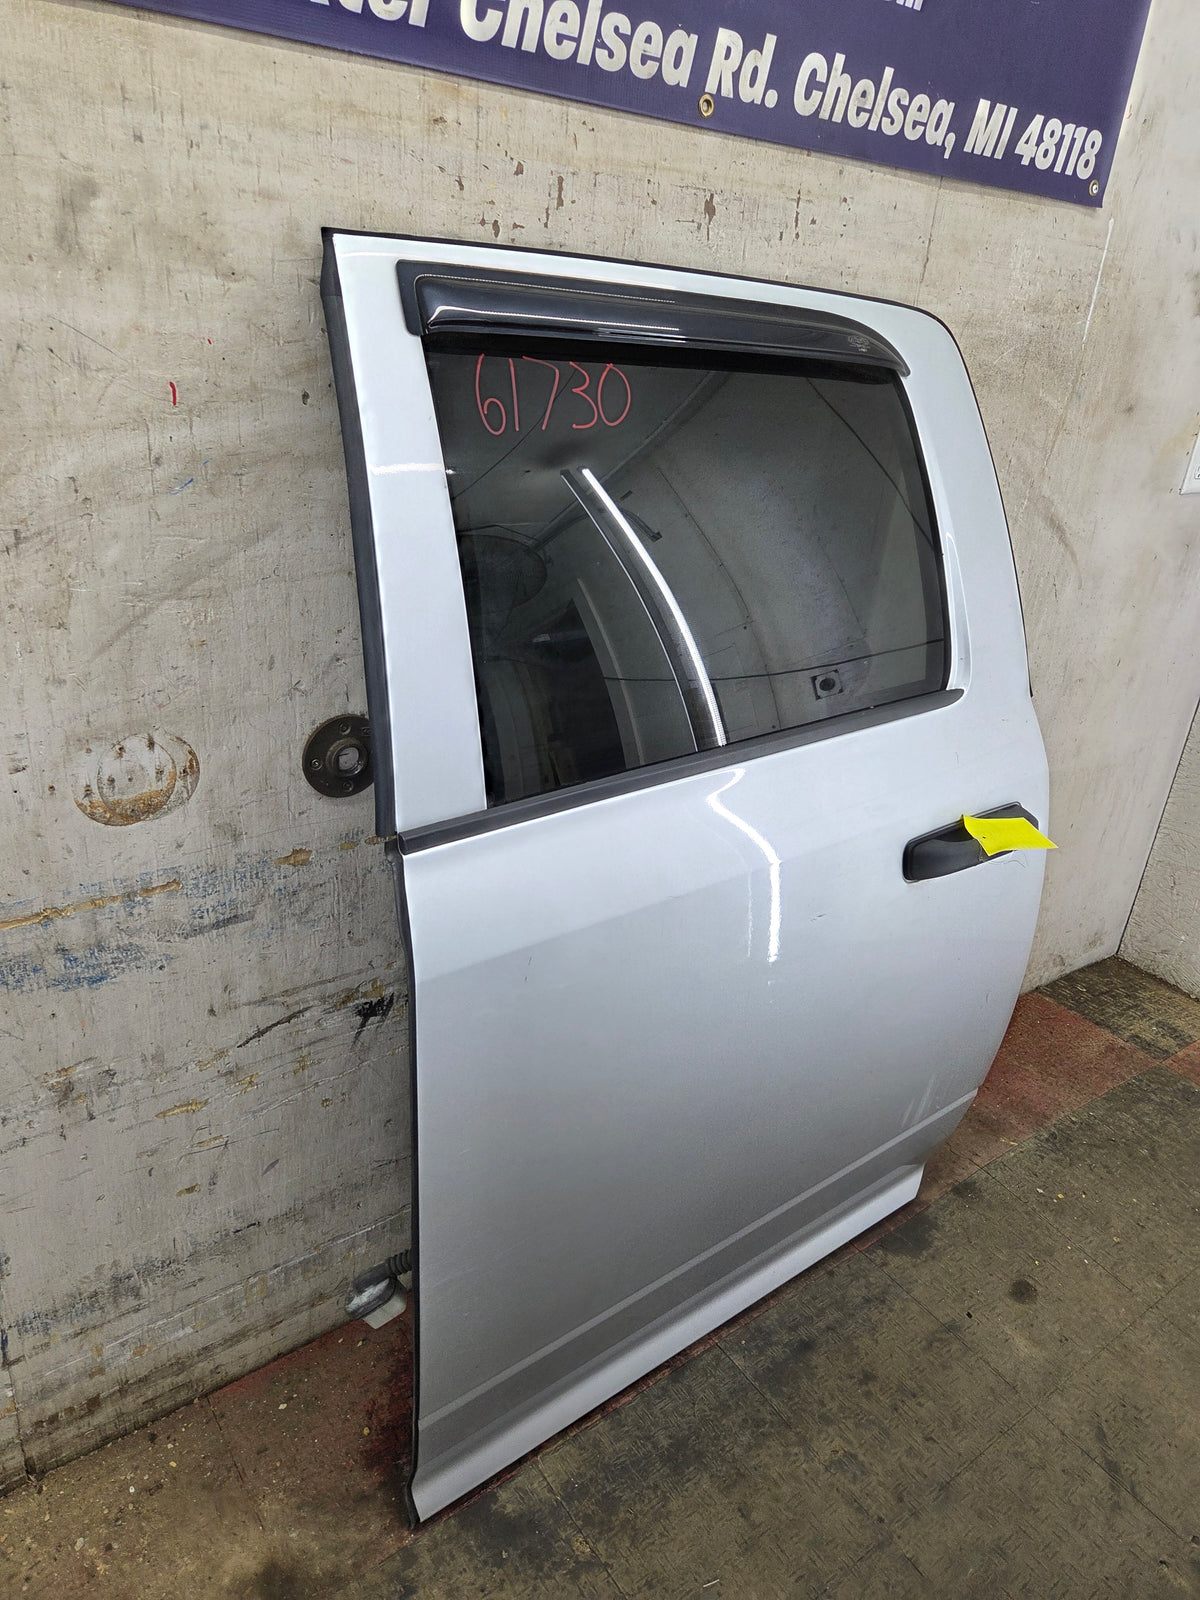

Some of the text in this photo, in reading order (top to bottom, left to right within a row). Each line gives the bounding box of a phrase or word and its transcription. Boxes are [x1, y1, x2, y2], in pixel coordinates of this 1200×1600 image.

[704, 27, 779, 109] Rd.
[794, 52, 956, 159] Chelsea,
[963, 98, 1018, 159] MI
[1014, 114, 1103, 180] 48118
[475, 353, 631, 436] 61730
